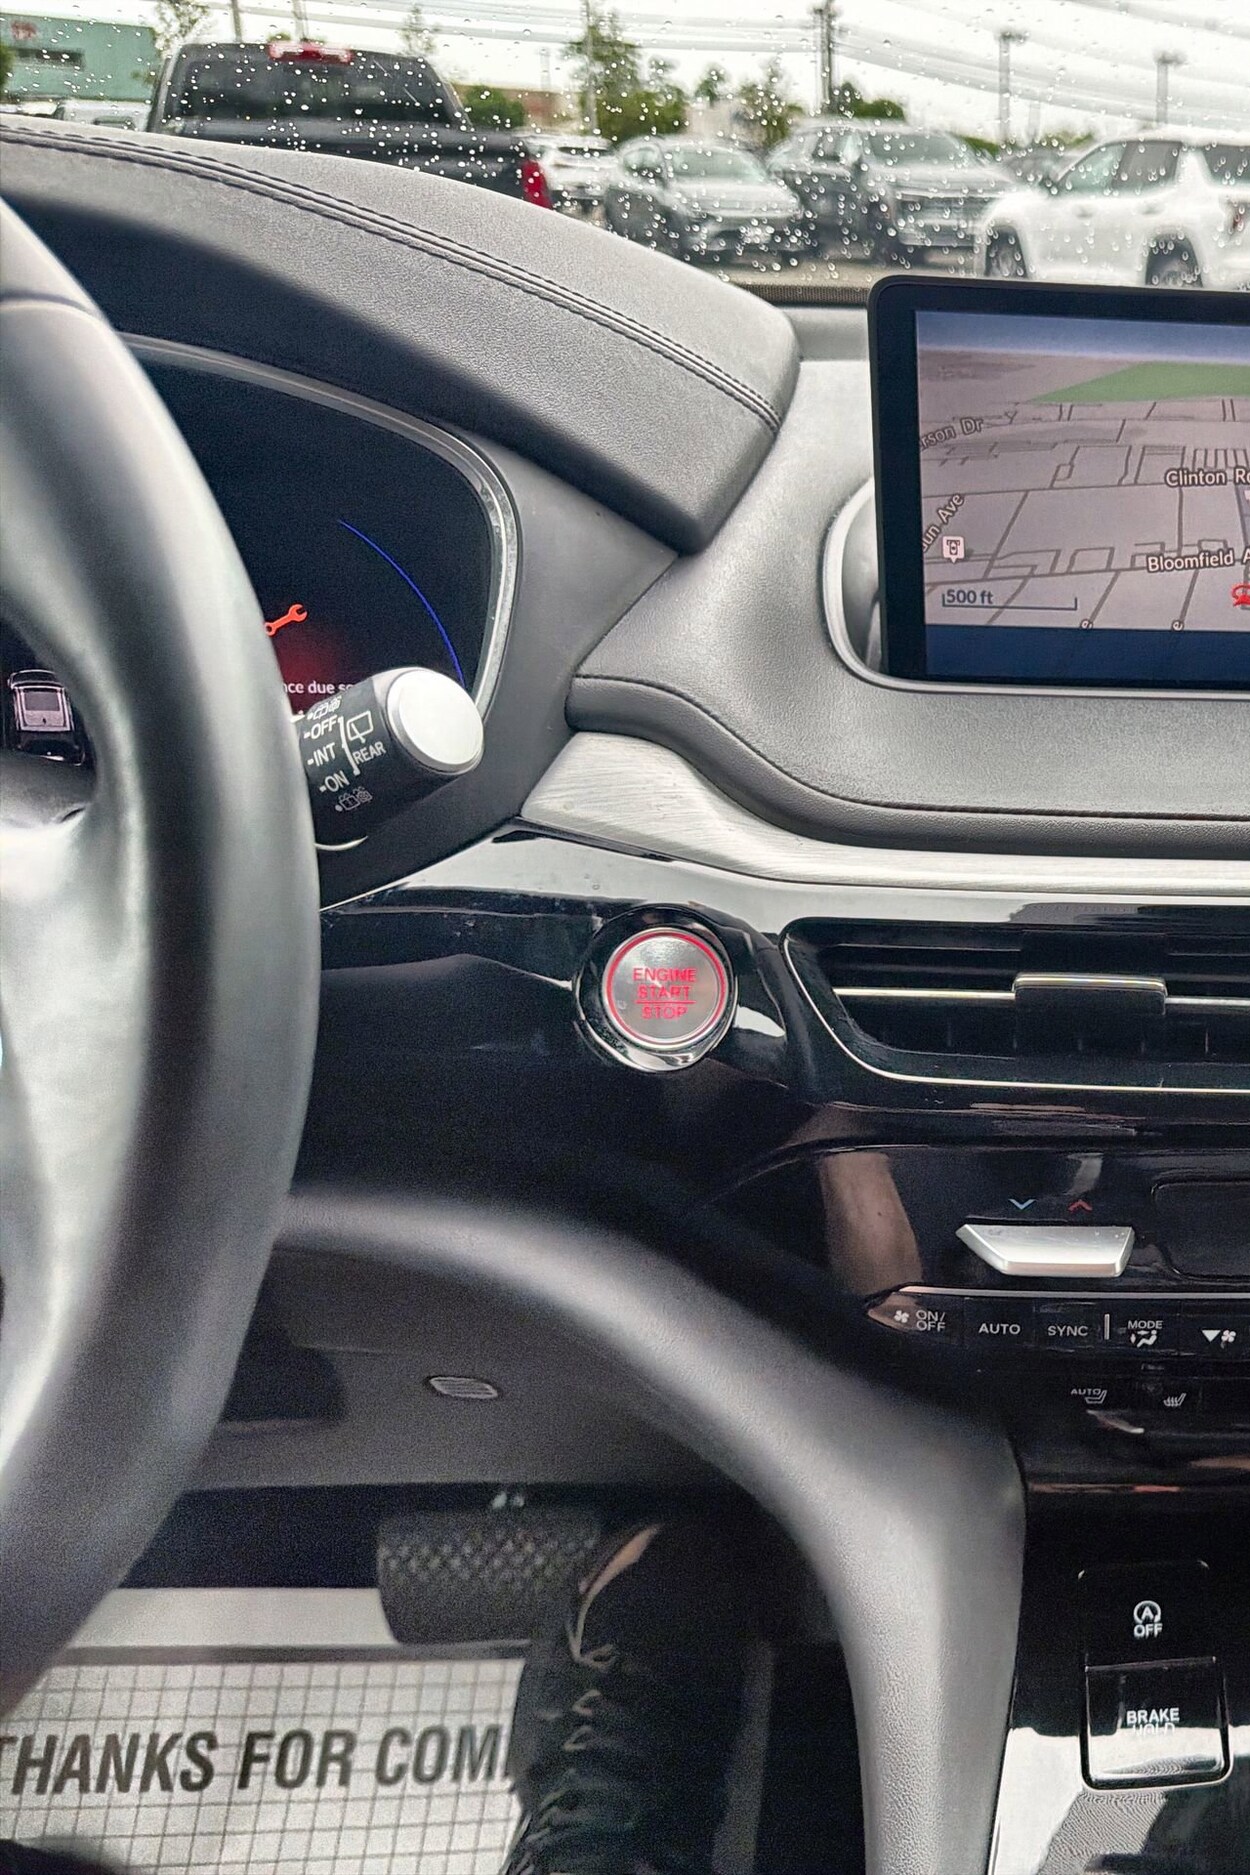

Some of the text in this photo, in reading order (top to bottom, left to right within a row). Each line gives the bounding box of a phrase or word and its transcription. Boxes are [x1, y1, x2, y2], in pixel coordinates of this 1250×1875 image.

[961, 416, 984, 435] Dr
[1165, 467, 1226, 487] Clinton
[936, 493, 965, 525] Ave
[1147, 550, 1235, 573] Bloomfield
[946, 589, 994, 605] 500 ft
[308, 680, 335, 694] due
[311, 715, 337, 740] OFF
[314, 743, 336, 767] INT
[353, 741, 387, 766] REAR
[325, 771, 350, 793] ON
[632, 968, 697, 983] ENGINE
[637, 986, 691, 999] START
[642, 1006, 688, 1020] STOP
[916, 1310, 946, 1322] ON/
[916, 1321, 946, 1332] OFF
[978, 1323, 1021, 1336] AUTO
[1047, 1325, 1089, 1337] SYNC
[1127, 1320, 1163, 1330] MODE
[1070, 1388, 1101, 1396] AUTO
[1133, 1623, 1163, 1638] OFF
[1126, 1707, 1180, 1725] BRAKE
[237, 1728, 358, 1790] FOR
[375, 1723, 511, 1786] COM
